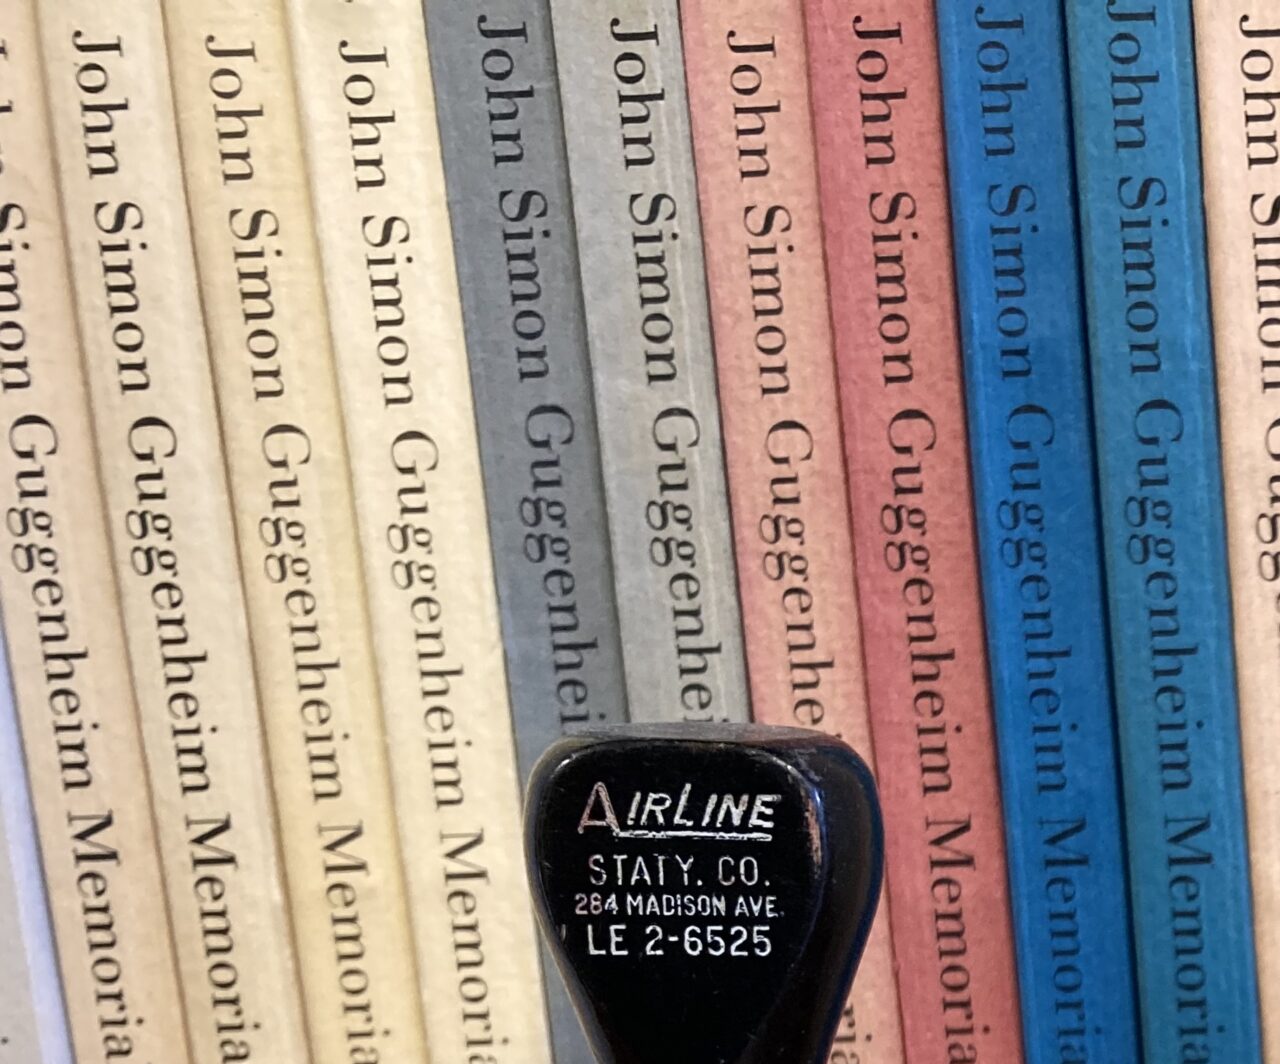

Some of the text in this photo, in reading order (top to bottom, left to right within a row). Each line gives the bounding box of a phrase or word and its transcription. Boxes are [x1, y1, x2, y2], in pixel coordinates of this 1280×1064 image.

[72, 30, 129, 178] John
[205, 34, 264, 184] John
[338, 39, 396, 191] John
[477, 14, 535, 169] John
[609, 17, 666, 171] John
[726, 29, 781, 181] John
[852, 15, 908, 170] John
[974, 5, 1029, 159] John
[1105, 0, 1160, 154] John
[94, 201, 150, 394] Simon
[228, 208, 285, 401] Simon
[361, 215, 414, 408] Simon
[498, 189, 551, 384] Simon
[628, 192, 679, 386] Simon
[743, 204, 795, 398] Simon
[868, 191, 919, 388] Simon
[987, 183, 1039, 382] Simon
[1117, 175, 1170, 376] Simon
[7, 414, 92, 792] Guggenheim
[125, 416, 210, 796] Guggenheim
[259, 423, 342, 812] Guggenheim
[387, 430, 473, 810] Guggenheim
[518, 405, 608, 728] Guggenhei
[880, 408, 963, 798] Guggenheim
[995, 403, 1079, 797] Guggenheim
[1123, 398, 1205, 794] Guggenheim
[574, 892, 785, 917] 284 MADISON AVE.
[586, 924, 772, 956] LE 2-6525
[588, 853, 771, 886] STATY. CO.
